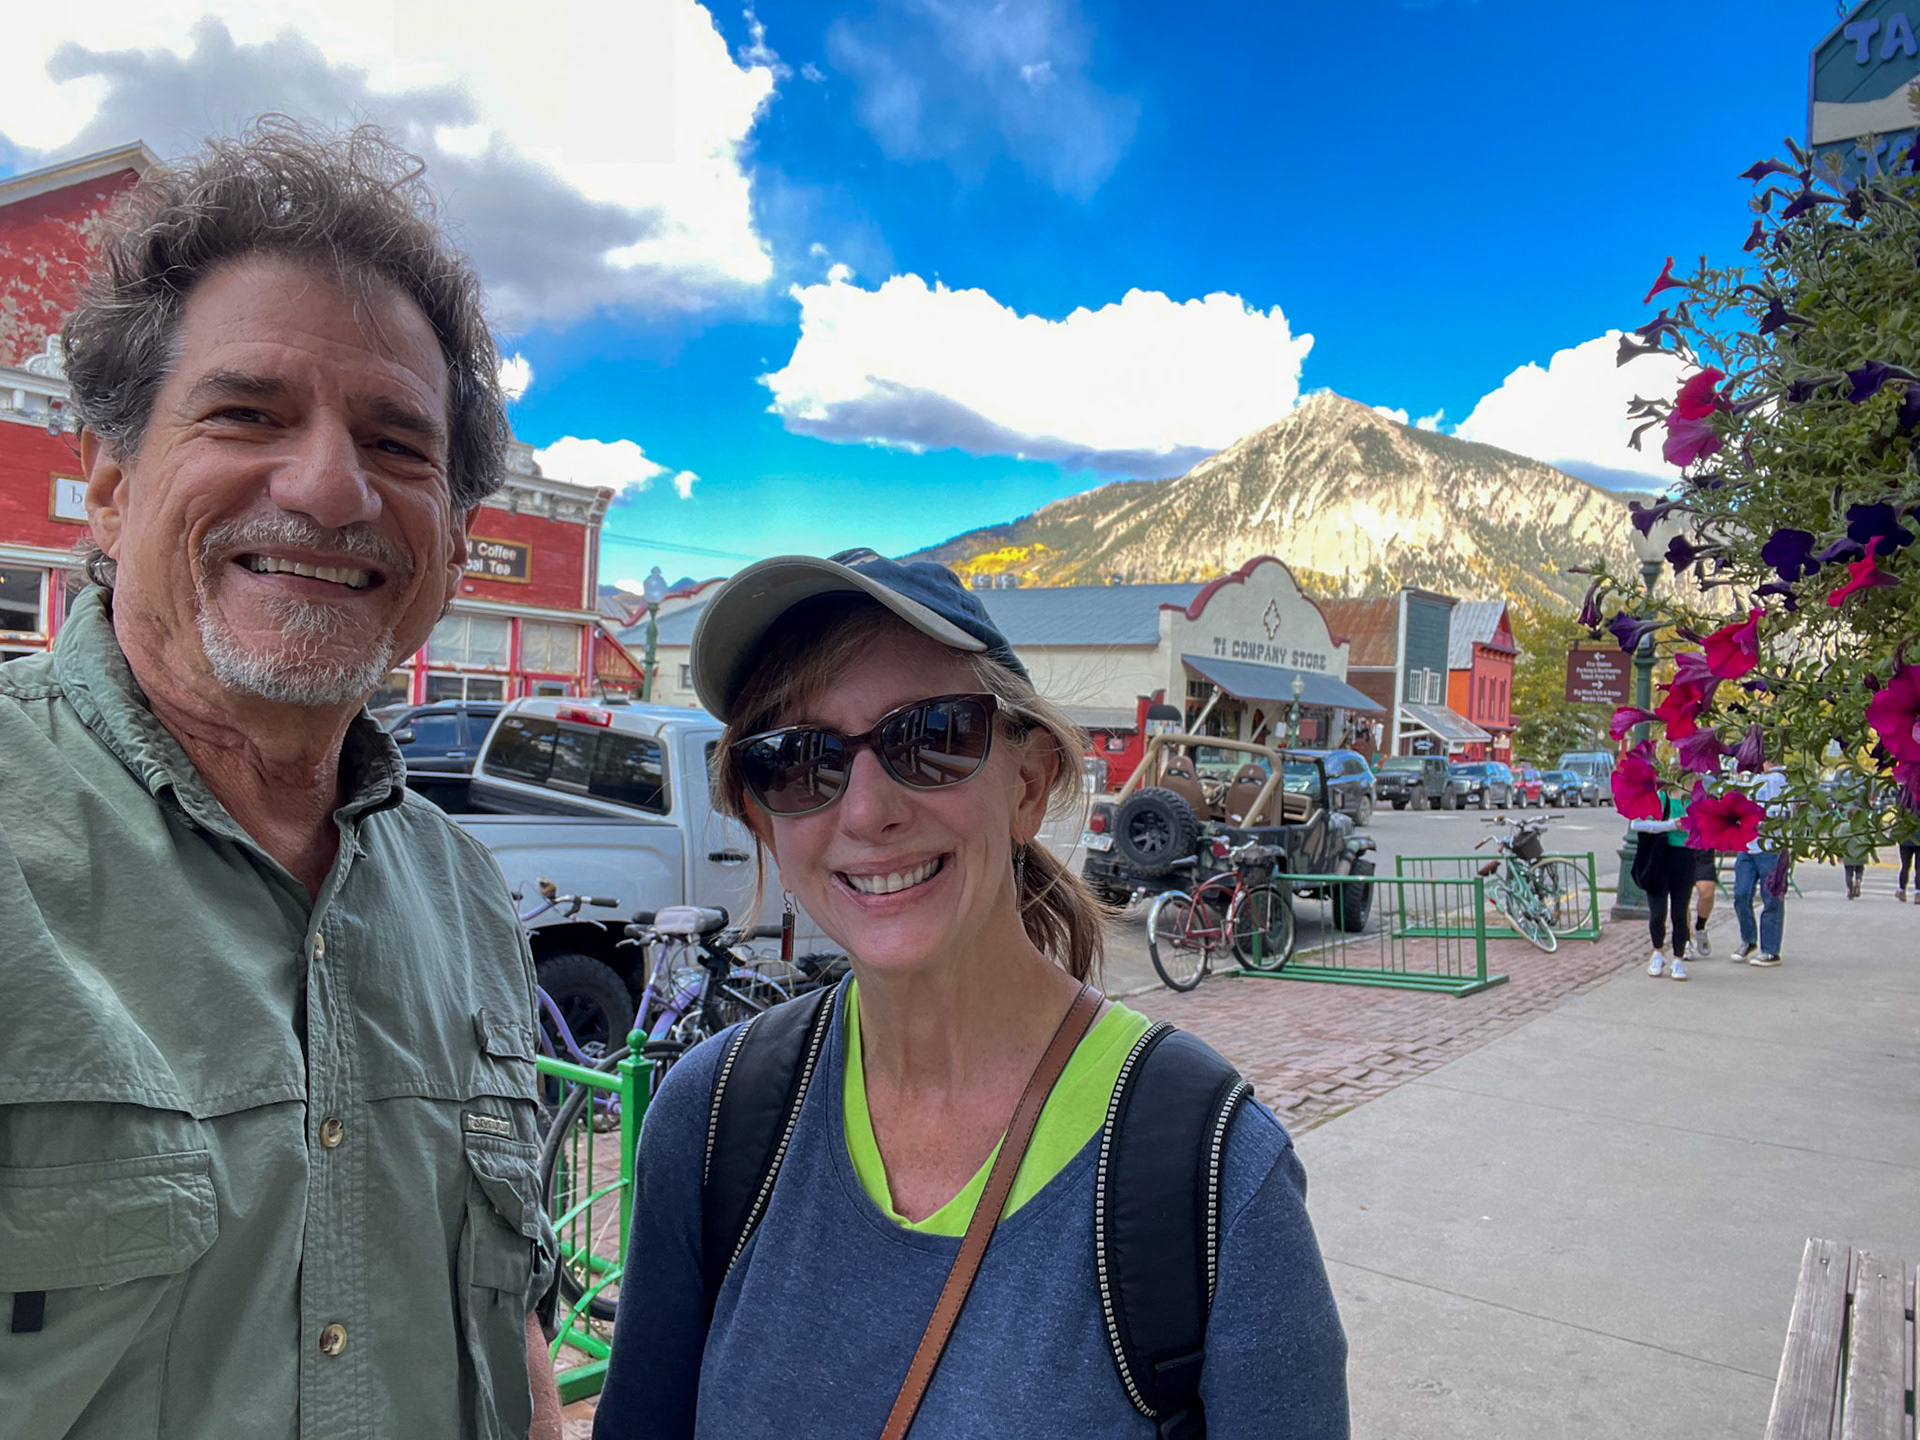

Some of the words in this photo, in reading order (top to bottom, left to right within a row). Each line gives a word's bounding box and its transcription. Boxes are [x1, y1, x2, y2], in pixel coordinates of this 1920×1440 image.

[477, 541, 517, 561] Coffee
[487, 560, 512, 576] Tea
[1232, 639, 1288, 665] COMPANY
[1291, 649, 1327, 671] STORE
